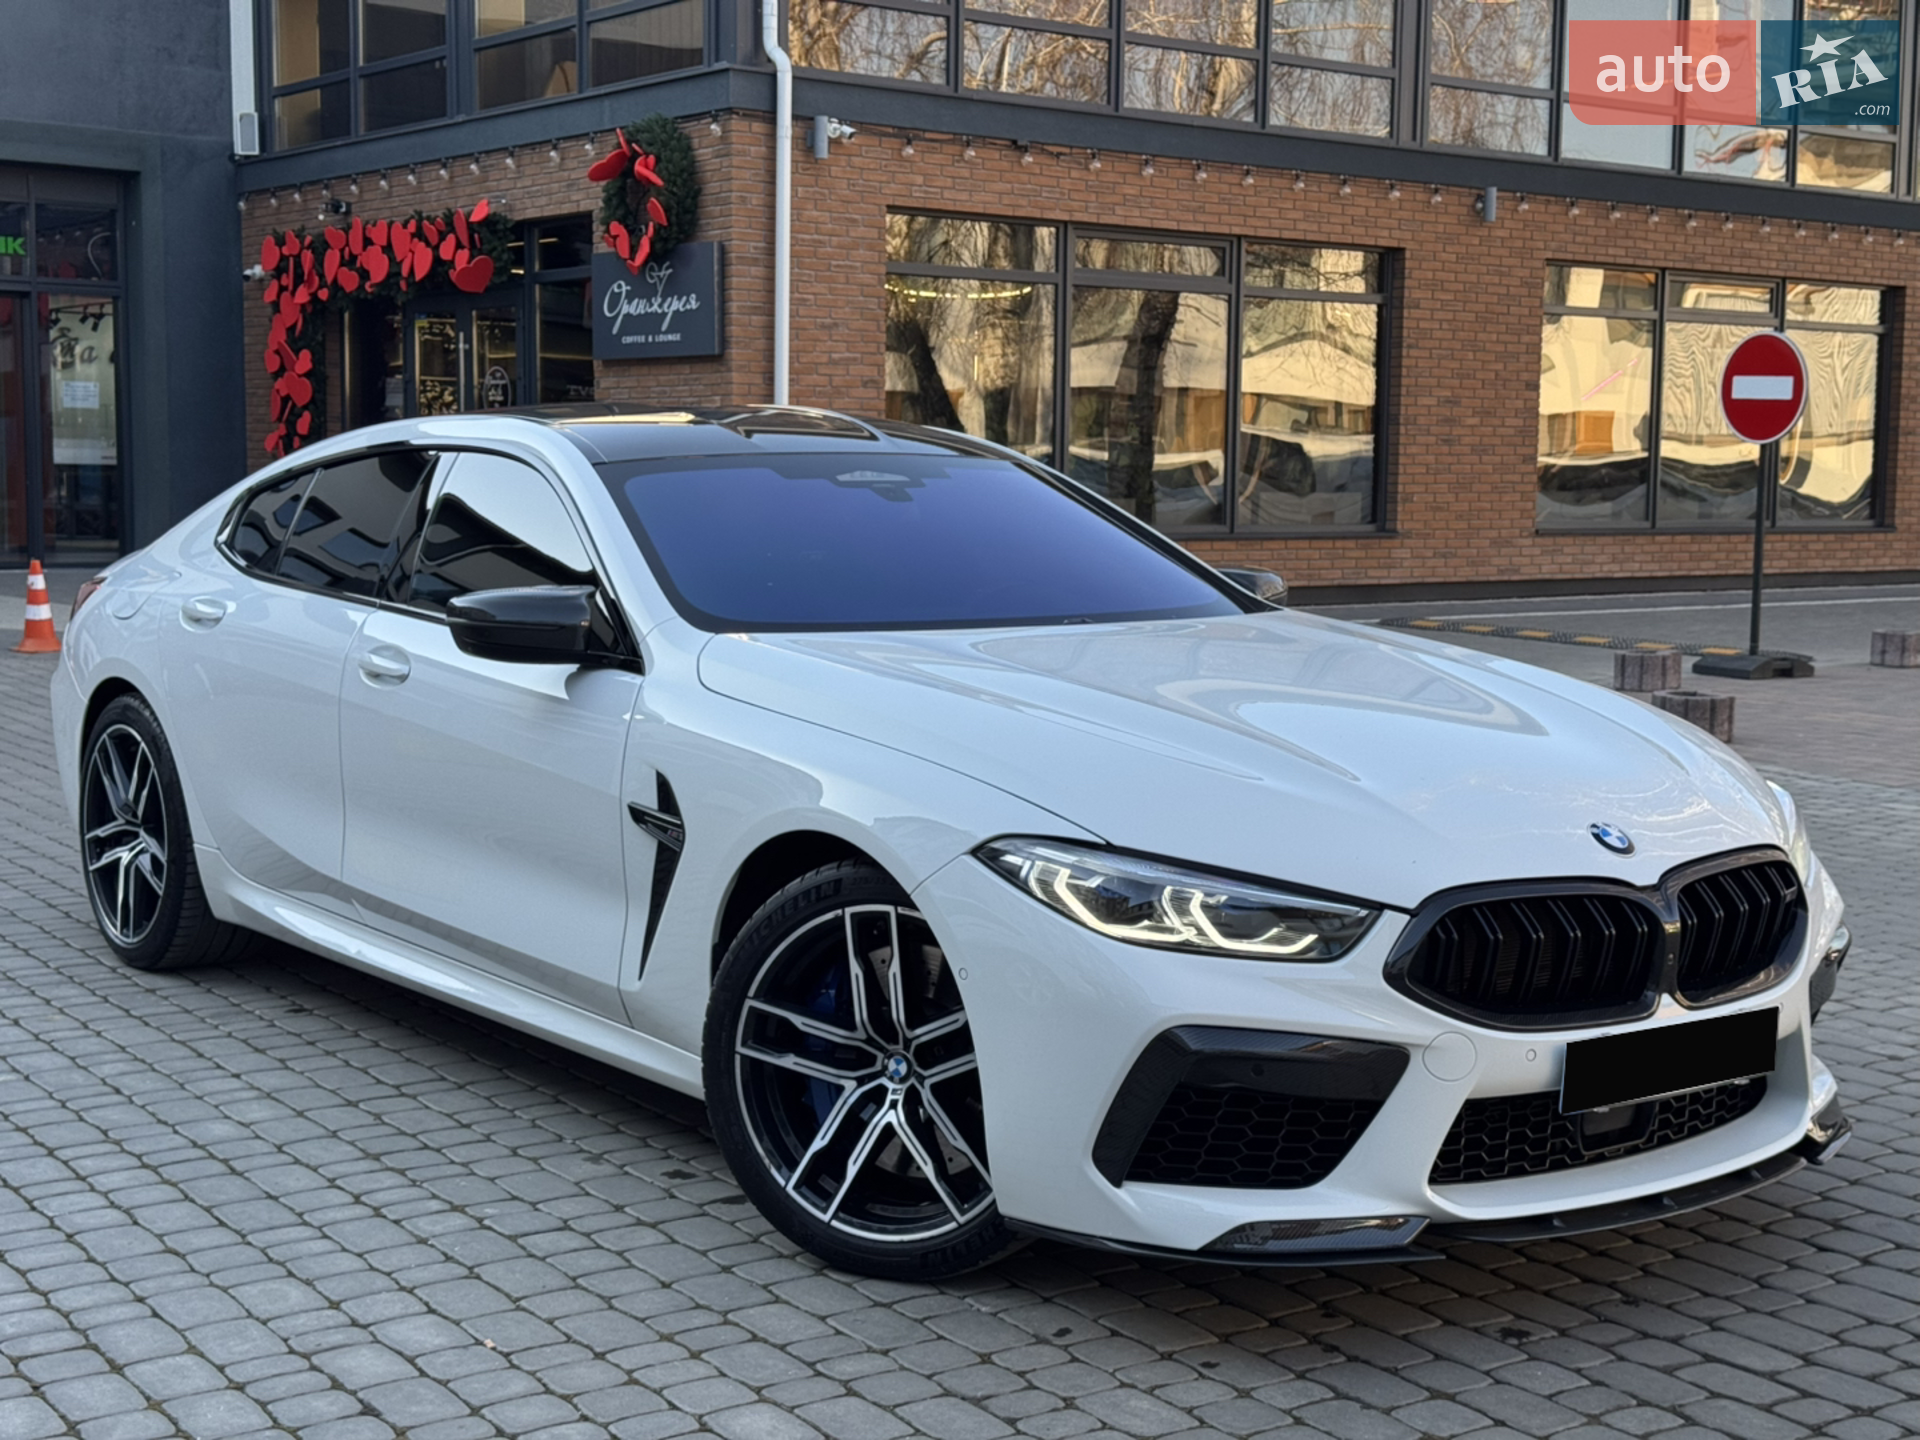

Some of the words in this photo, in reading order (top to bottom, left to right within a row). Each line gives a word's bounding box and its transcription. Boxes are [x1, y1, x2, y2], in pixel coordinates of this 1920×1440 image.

[603, 280, 701, 335] Оранжерея
[621, 335, 646, 344] COFFEE
[655, 333, 681, 342] LOUNGE
